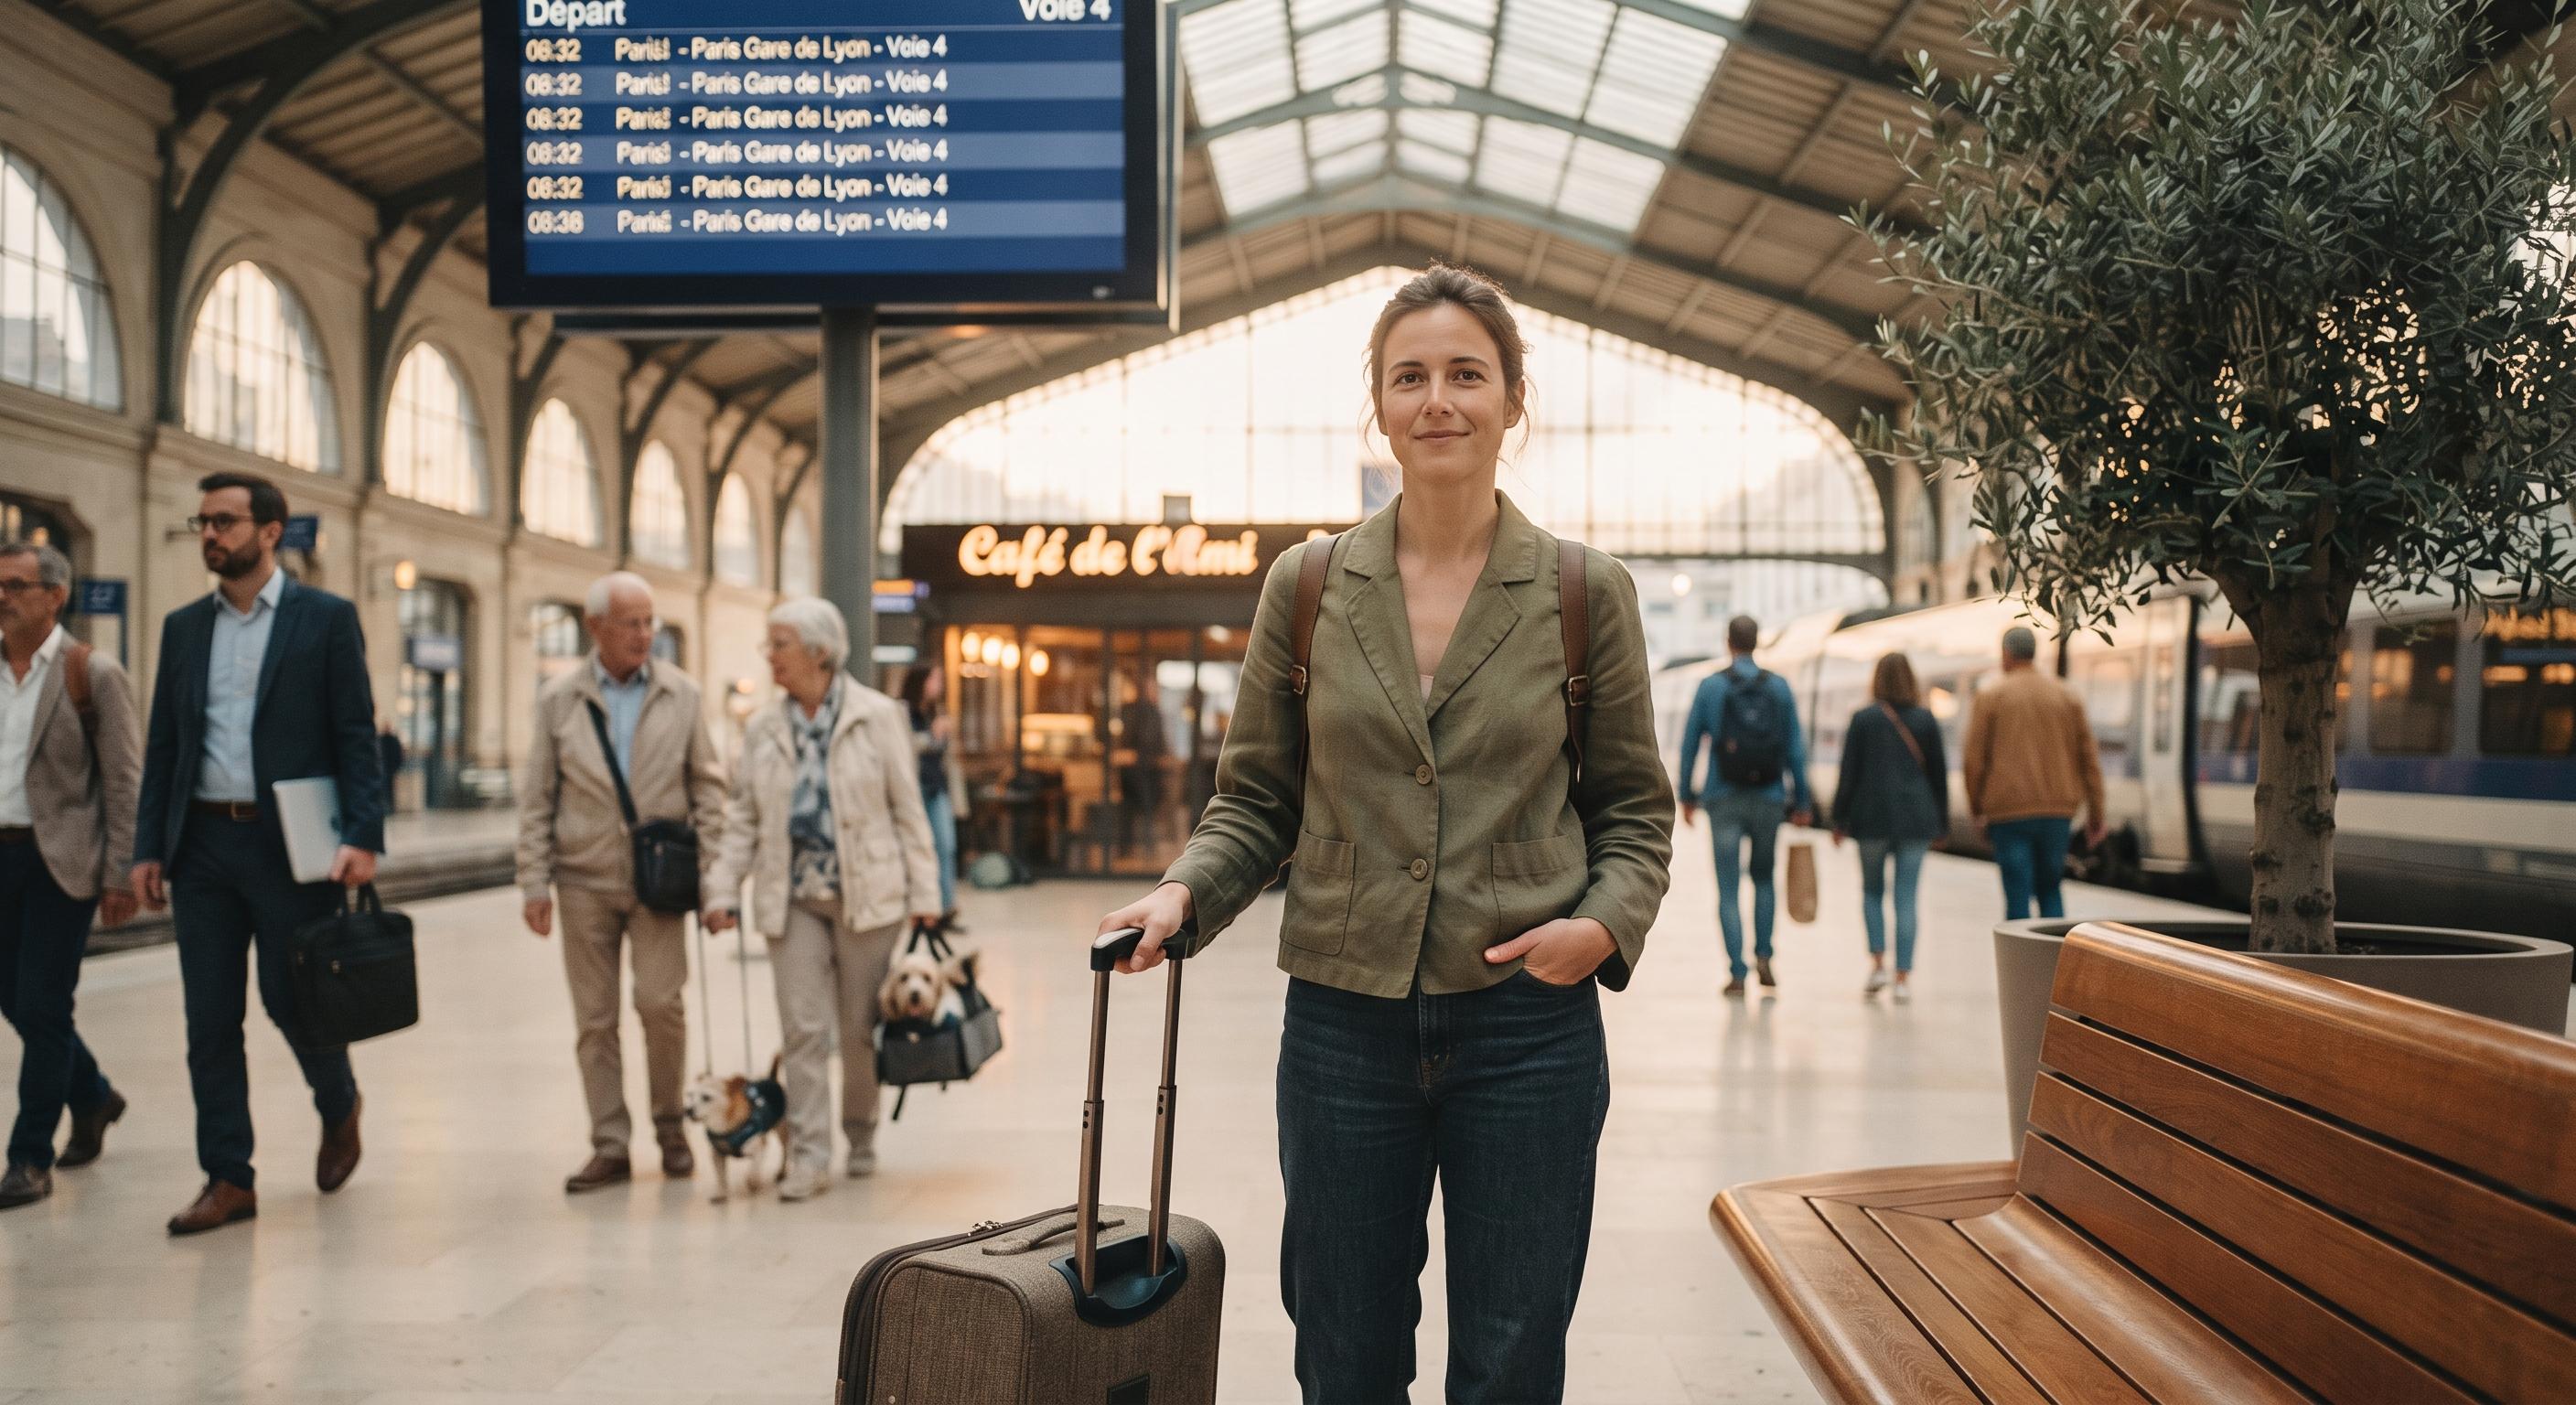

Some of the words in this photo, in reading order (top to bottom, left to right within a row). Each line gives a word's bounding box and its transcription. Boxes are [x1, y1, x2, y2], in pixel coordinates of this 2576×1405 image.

[1018, 0, 1086, 21] Voie
[1089, 0, 1111, 21] 4
[691, 37, 742, 60] Paris
[743, 36, 792, 60] Gare
[793, 36, 821, 59] de
[822, 36, 872, 64] Lyon
[885, 35, 931, 59] Voie
[931, 34, 948, 57] 4
[692, 70, 742, 95] Paris
[743, 70, 793, 95] Gare
[793, 70, 821, 95] de
[822, 70, 872, 99] Lyon
[885, 69, 932, 93] Voie
[932, 69, 949, 92] 4
[692, 105, 742, 130] Paris
[743, 105, 793, 130] Gare
[794, 105, 821, 129] de
[822, 105, 873, 134] Lyon
[885, 103, 932, 128] Voie
[932, 103, 949, 126] 4
[692, 140, 743, 165] Paris
[744, 139, 794, 164] Gare
[794, 139, 822, 164] de
[822, 139, 873, 168] Lyon
[886, 137, 932, 163] Voie
[932, 138, 949, 162] 4
[692, 175, 743, 199] Paris
[744, 175, 794, 198] Gare
[794, 174, 822, 198] de
[823, 175, 873, 203] Lyon
[886, 172, 932, 198] Voie
[932, 173, 949, 196] 4
[692, 209, 743, 233] Paris
[744, 208, 794, 233] Gare
[794, 209, 822, 232] de
[823, 208, 873, 237] Lyon
[886, 207, 932, 231] Voie
[932, 207, 949, 231] 4
[958, 525, 1068, 588] Café
[1069, 525, 1128, 576] de
